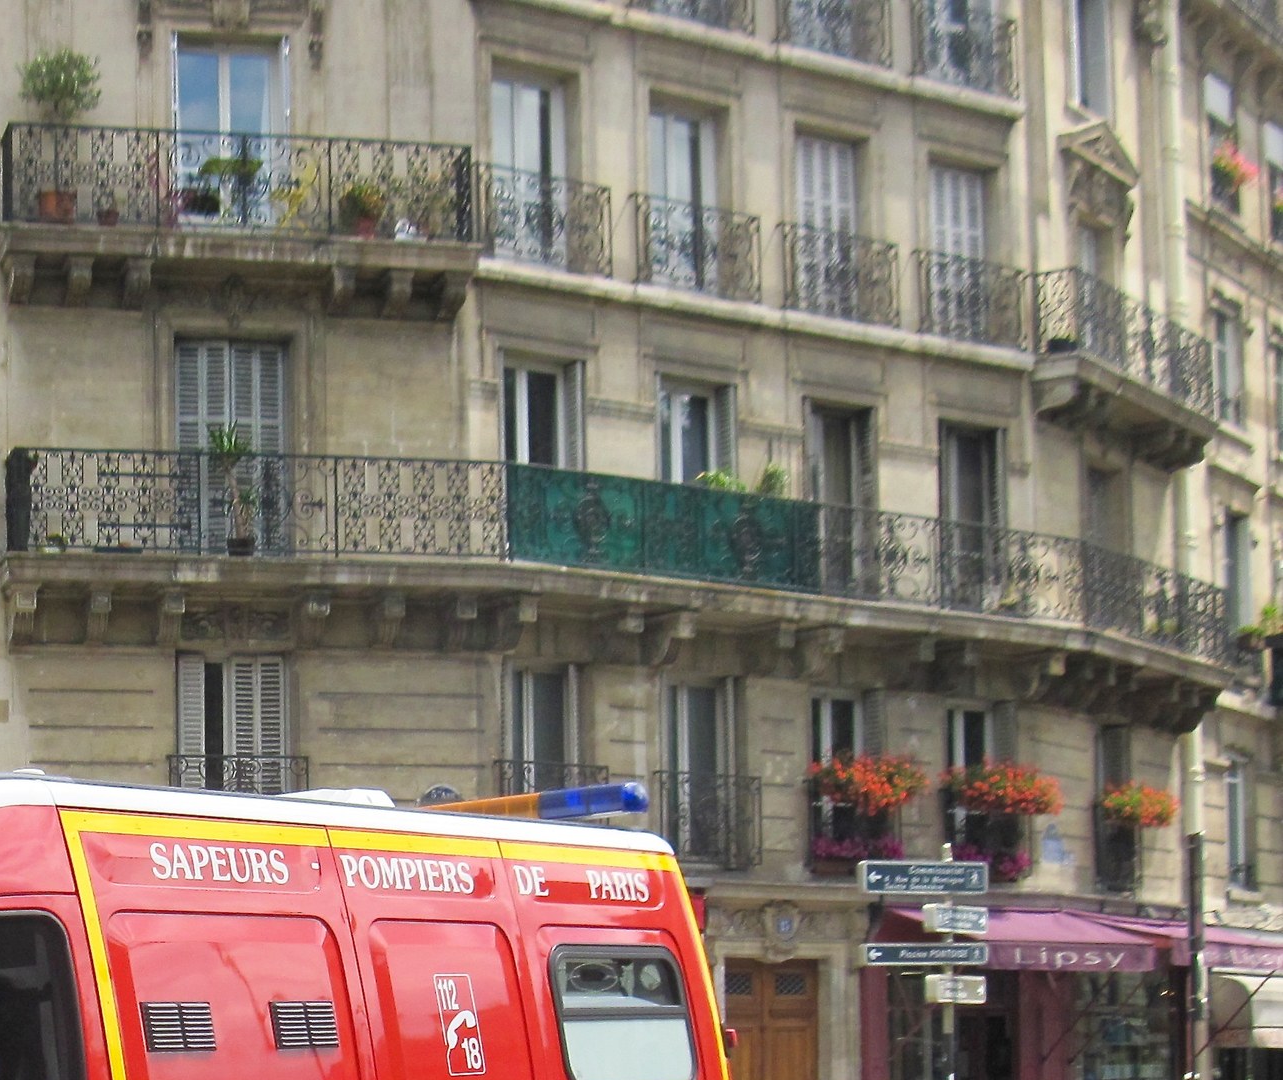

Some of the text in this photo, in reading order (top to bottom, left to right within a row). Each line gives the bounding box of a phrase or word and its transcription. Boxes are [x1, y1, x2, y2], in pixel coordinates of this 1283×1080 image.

[149, 842, 290, 885] SAPEURS
[339, 854, 474, 895] POMPIERS
[513, 864, 550, 897] DE
[585, 869, 650, 903] PARIS
[1014, 947, 1126, 968] Lipsy
[437, 979, 460, 1010] 112
[461, 1037, 482, 1069] 18
